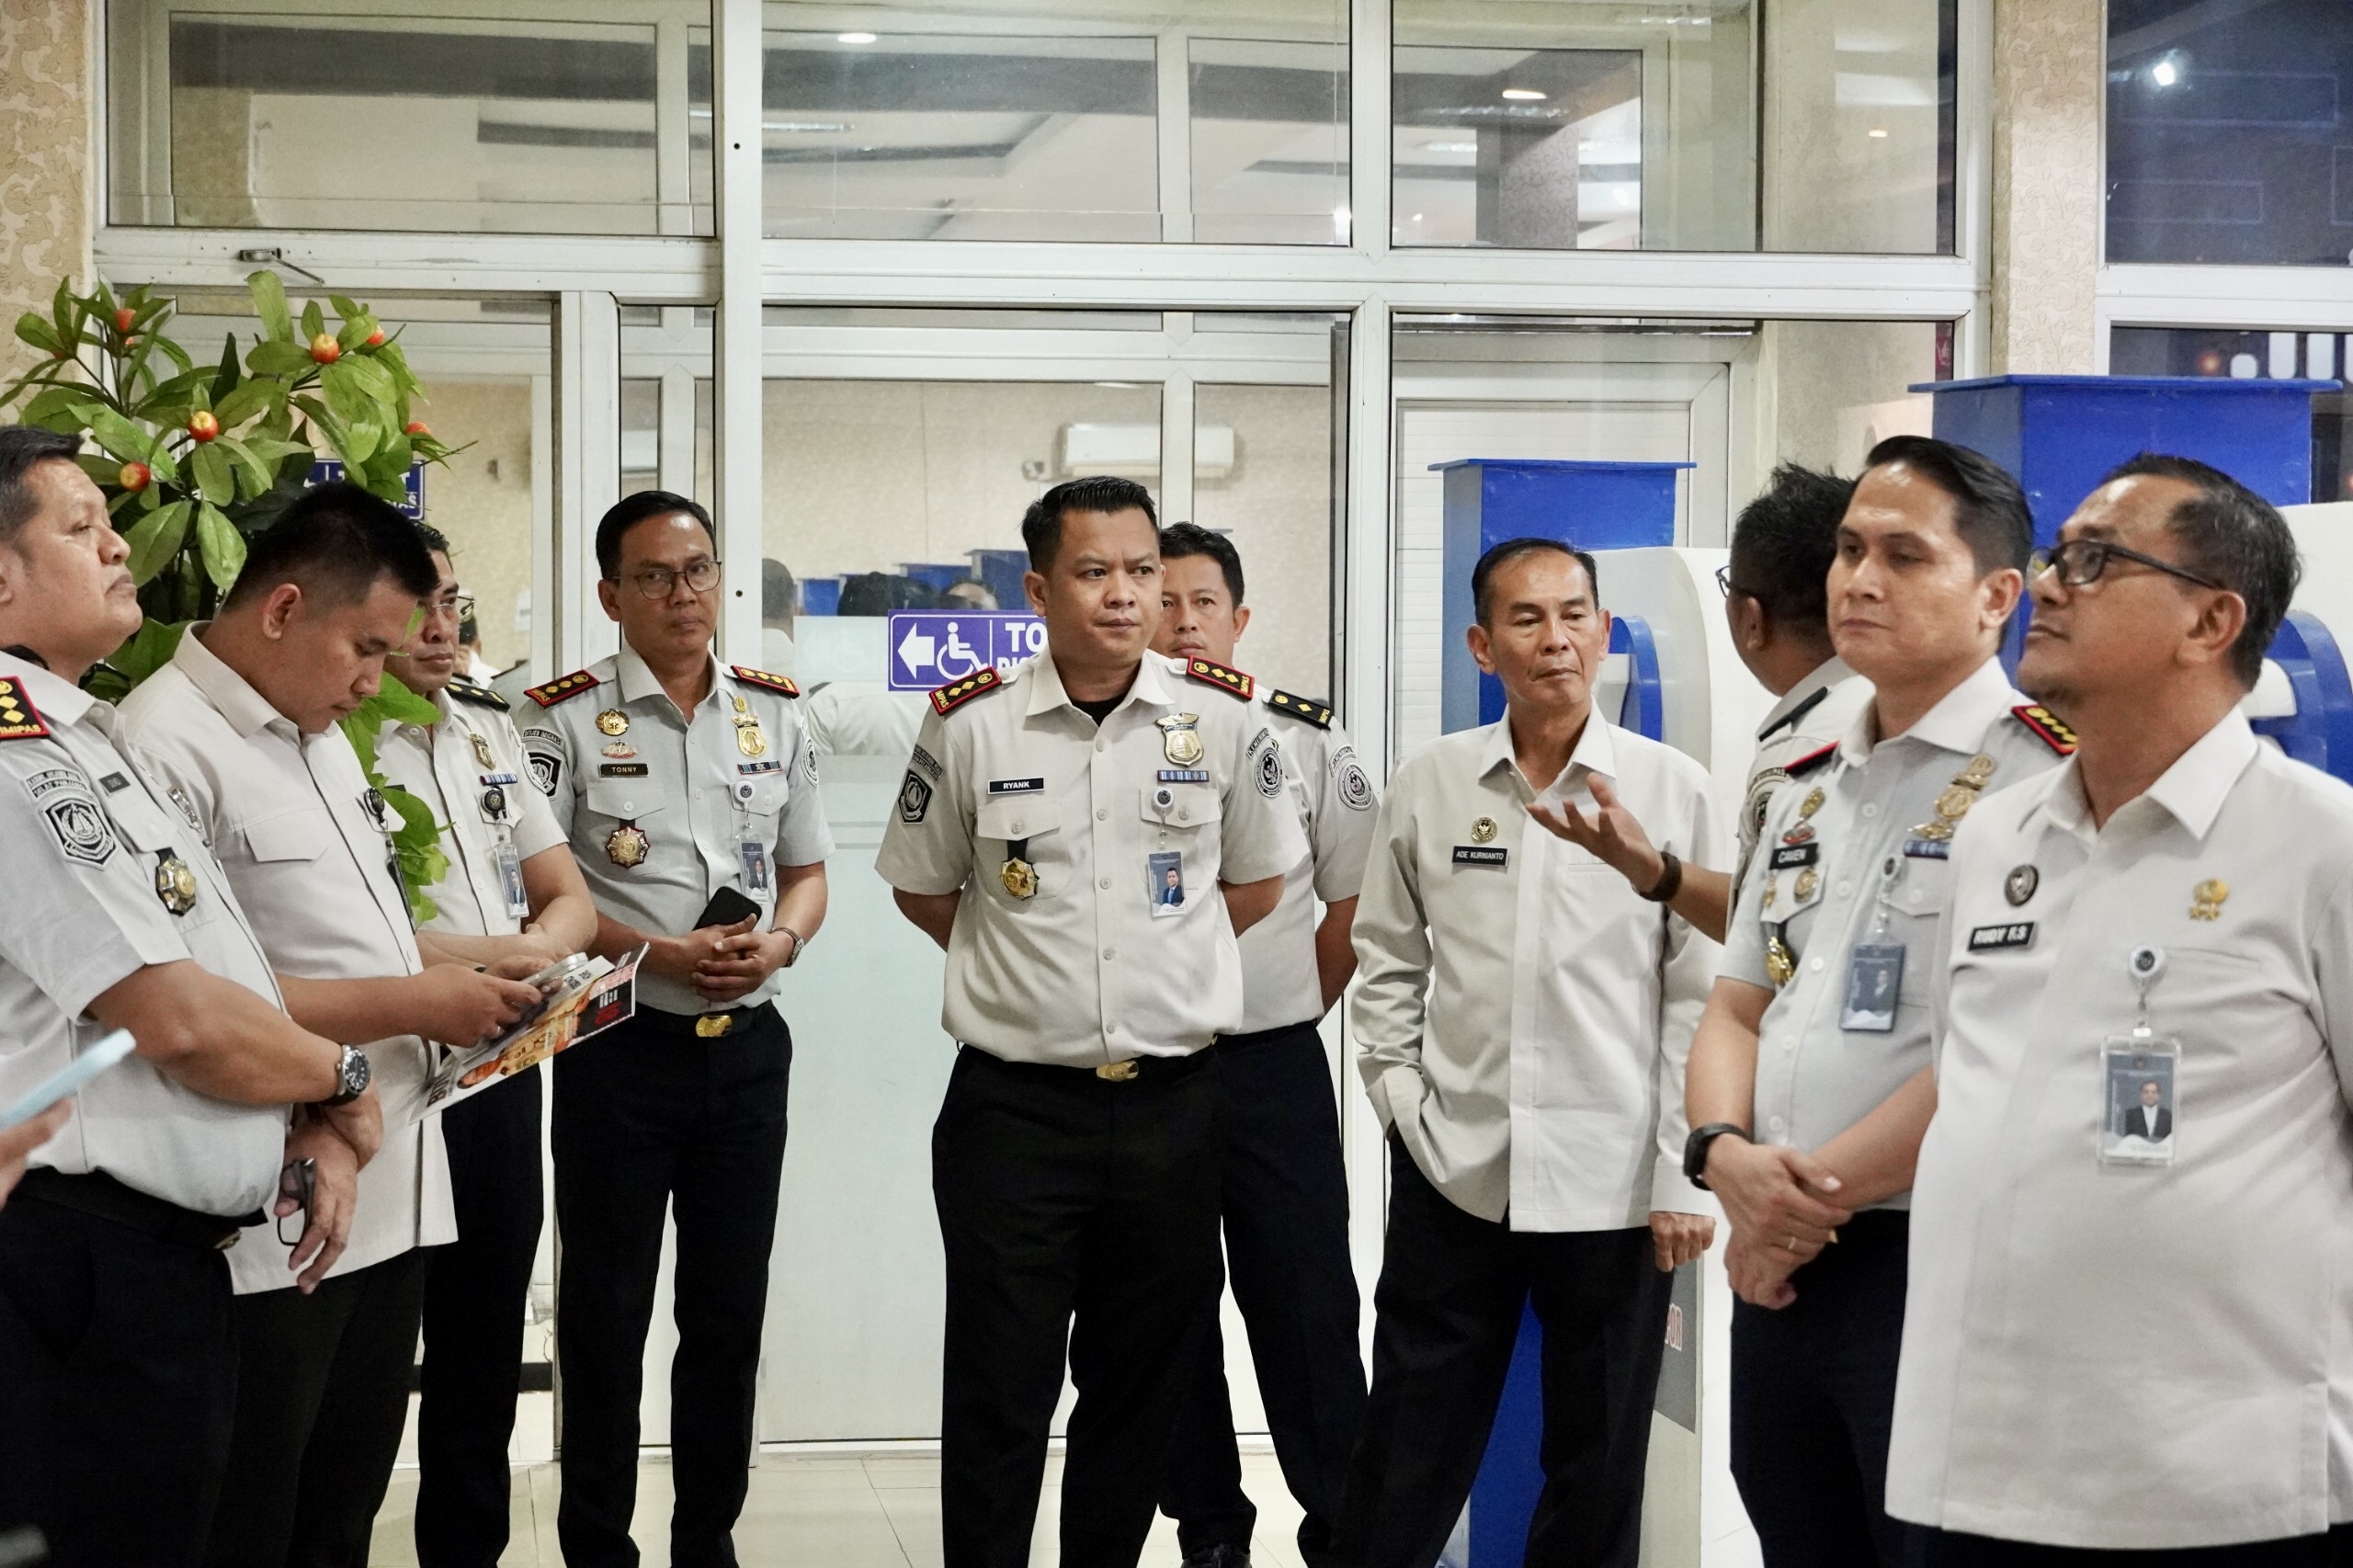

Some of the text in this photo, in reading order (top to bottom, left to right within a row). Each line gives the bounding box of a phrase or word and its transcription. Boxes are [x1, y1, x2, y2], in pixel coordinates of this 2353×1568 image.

[1003, 781, 1030, 790] RYANK
[1456, 850, 1504, 859] ADE KURNIANTO
